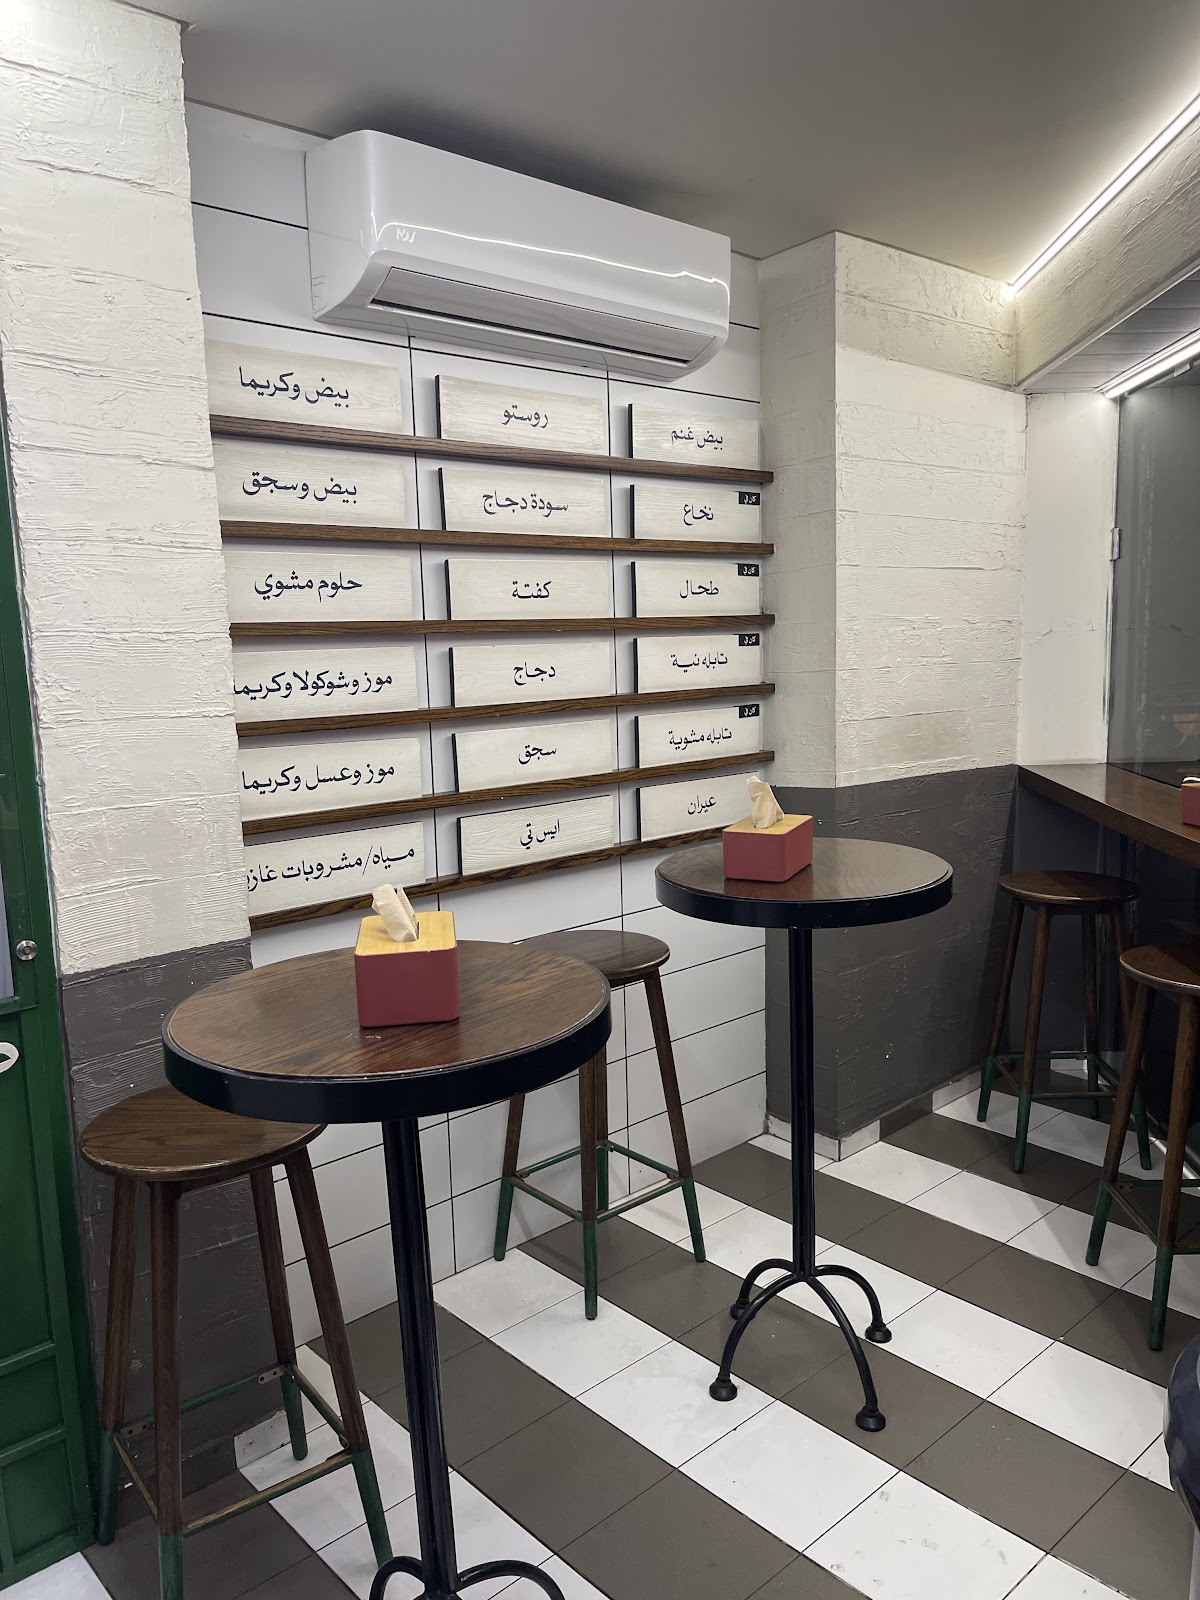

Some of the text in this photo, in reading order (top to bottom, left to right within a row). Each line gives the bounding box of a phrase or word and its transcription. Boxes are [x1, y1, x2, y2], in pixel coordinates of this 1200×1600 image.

[238, 365, 350, 409] بيض وكريما
[501, 404, 549, 428] روستو
[671, 427, 723, 451] بيض غنم
[242, 471, 357, 505] بيض وسجق
[482, 490, 569, 518] سودة دجاج
[683, 503, 714, 527] نخاع
[254, 571, 363, 603] حلوم مشوي
[511, 580, 552, 600] كفتة
[679, 579, 720, 600] طحال
[513, 661, 556, 686] دجاج
[670, 653, 700, 674] نية
[293, 669, 360, 697] وشوكولا
[361, 671, 393, 695] موز
[668, 729, 705, 751] مشوية
[518, 744, 557, 765] سجق
[241, 763, 395, 795] موز وعسل وكريما
[687, 794, 717, 815] عيران
[519, 818, 560, 850] ايس تي
